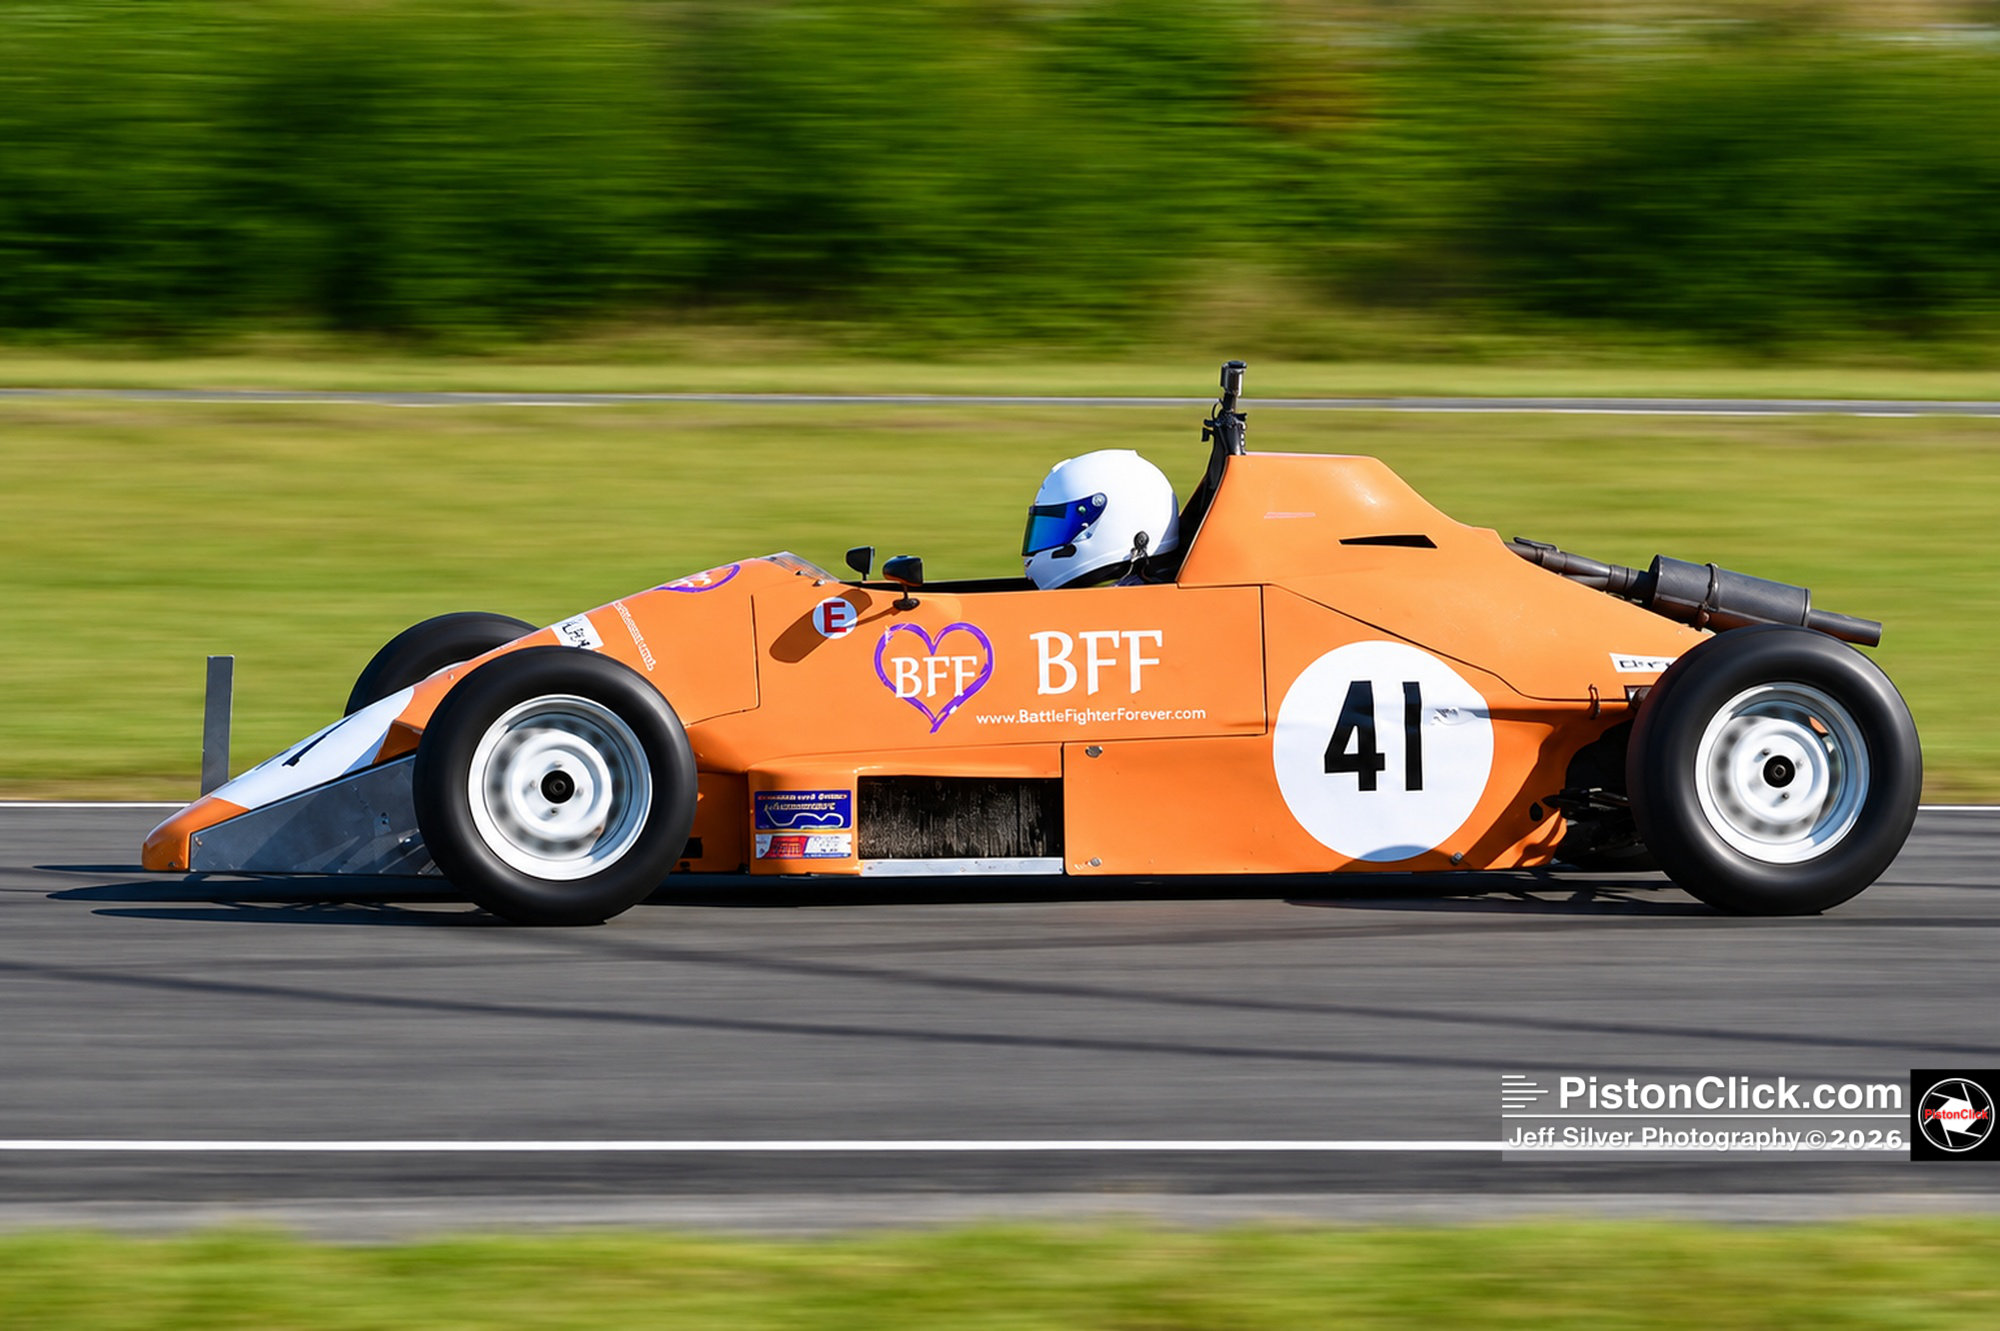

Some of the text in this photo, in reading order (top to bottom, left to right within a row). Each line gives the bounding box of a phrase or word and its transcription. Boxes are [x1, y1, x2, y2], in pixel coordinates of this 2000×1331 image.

[823, 601, 847, 633] E
[891, 656, 977, 698] BFF
[1029, 630, 1163, 695] BFF
[976, 708, 1206, 725] www.BattleFighterForever.com
[1324, 681, 1424, 793] 41
